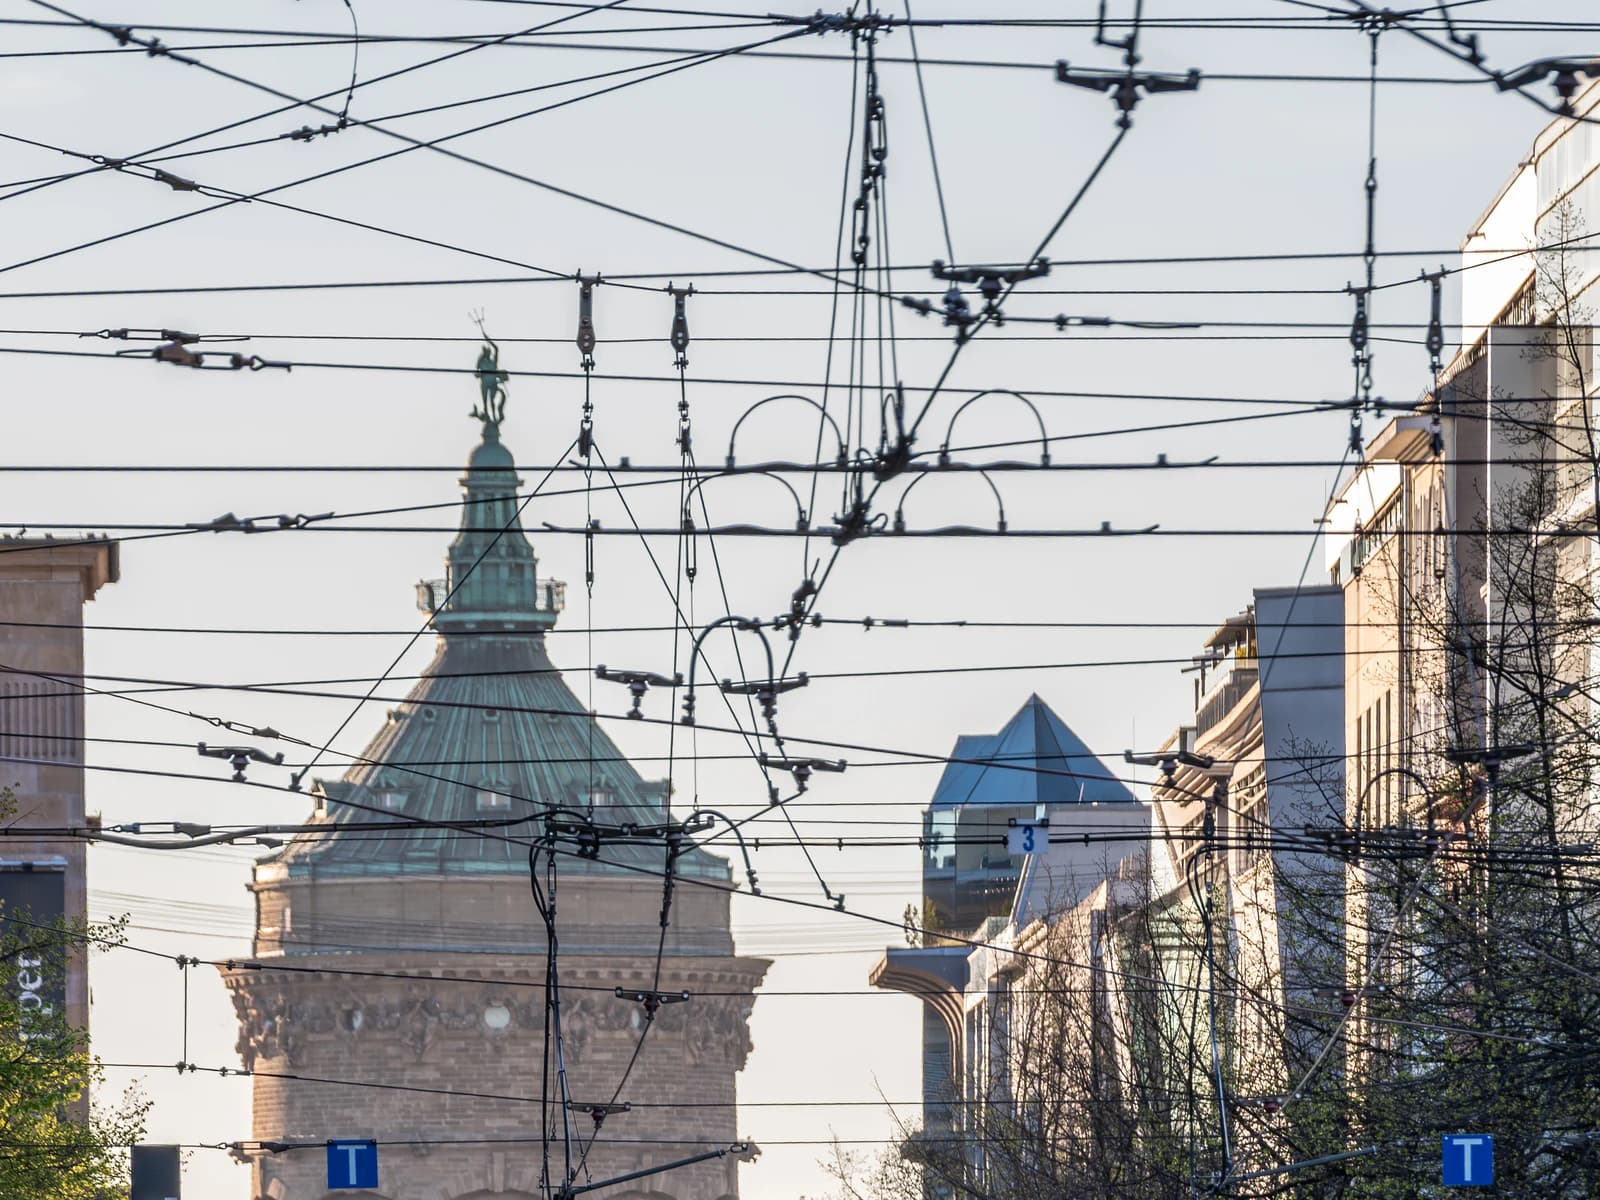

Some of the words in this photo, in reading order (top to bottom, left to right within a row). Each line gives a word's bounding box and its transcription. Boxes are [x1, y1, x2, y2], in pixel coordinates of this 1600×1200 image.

[1022, 826, 1034, 851] 3
[337, 1145, 367, 1185] T
[1453, 1139, 1483, 1181] T
